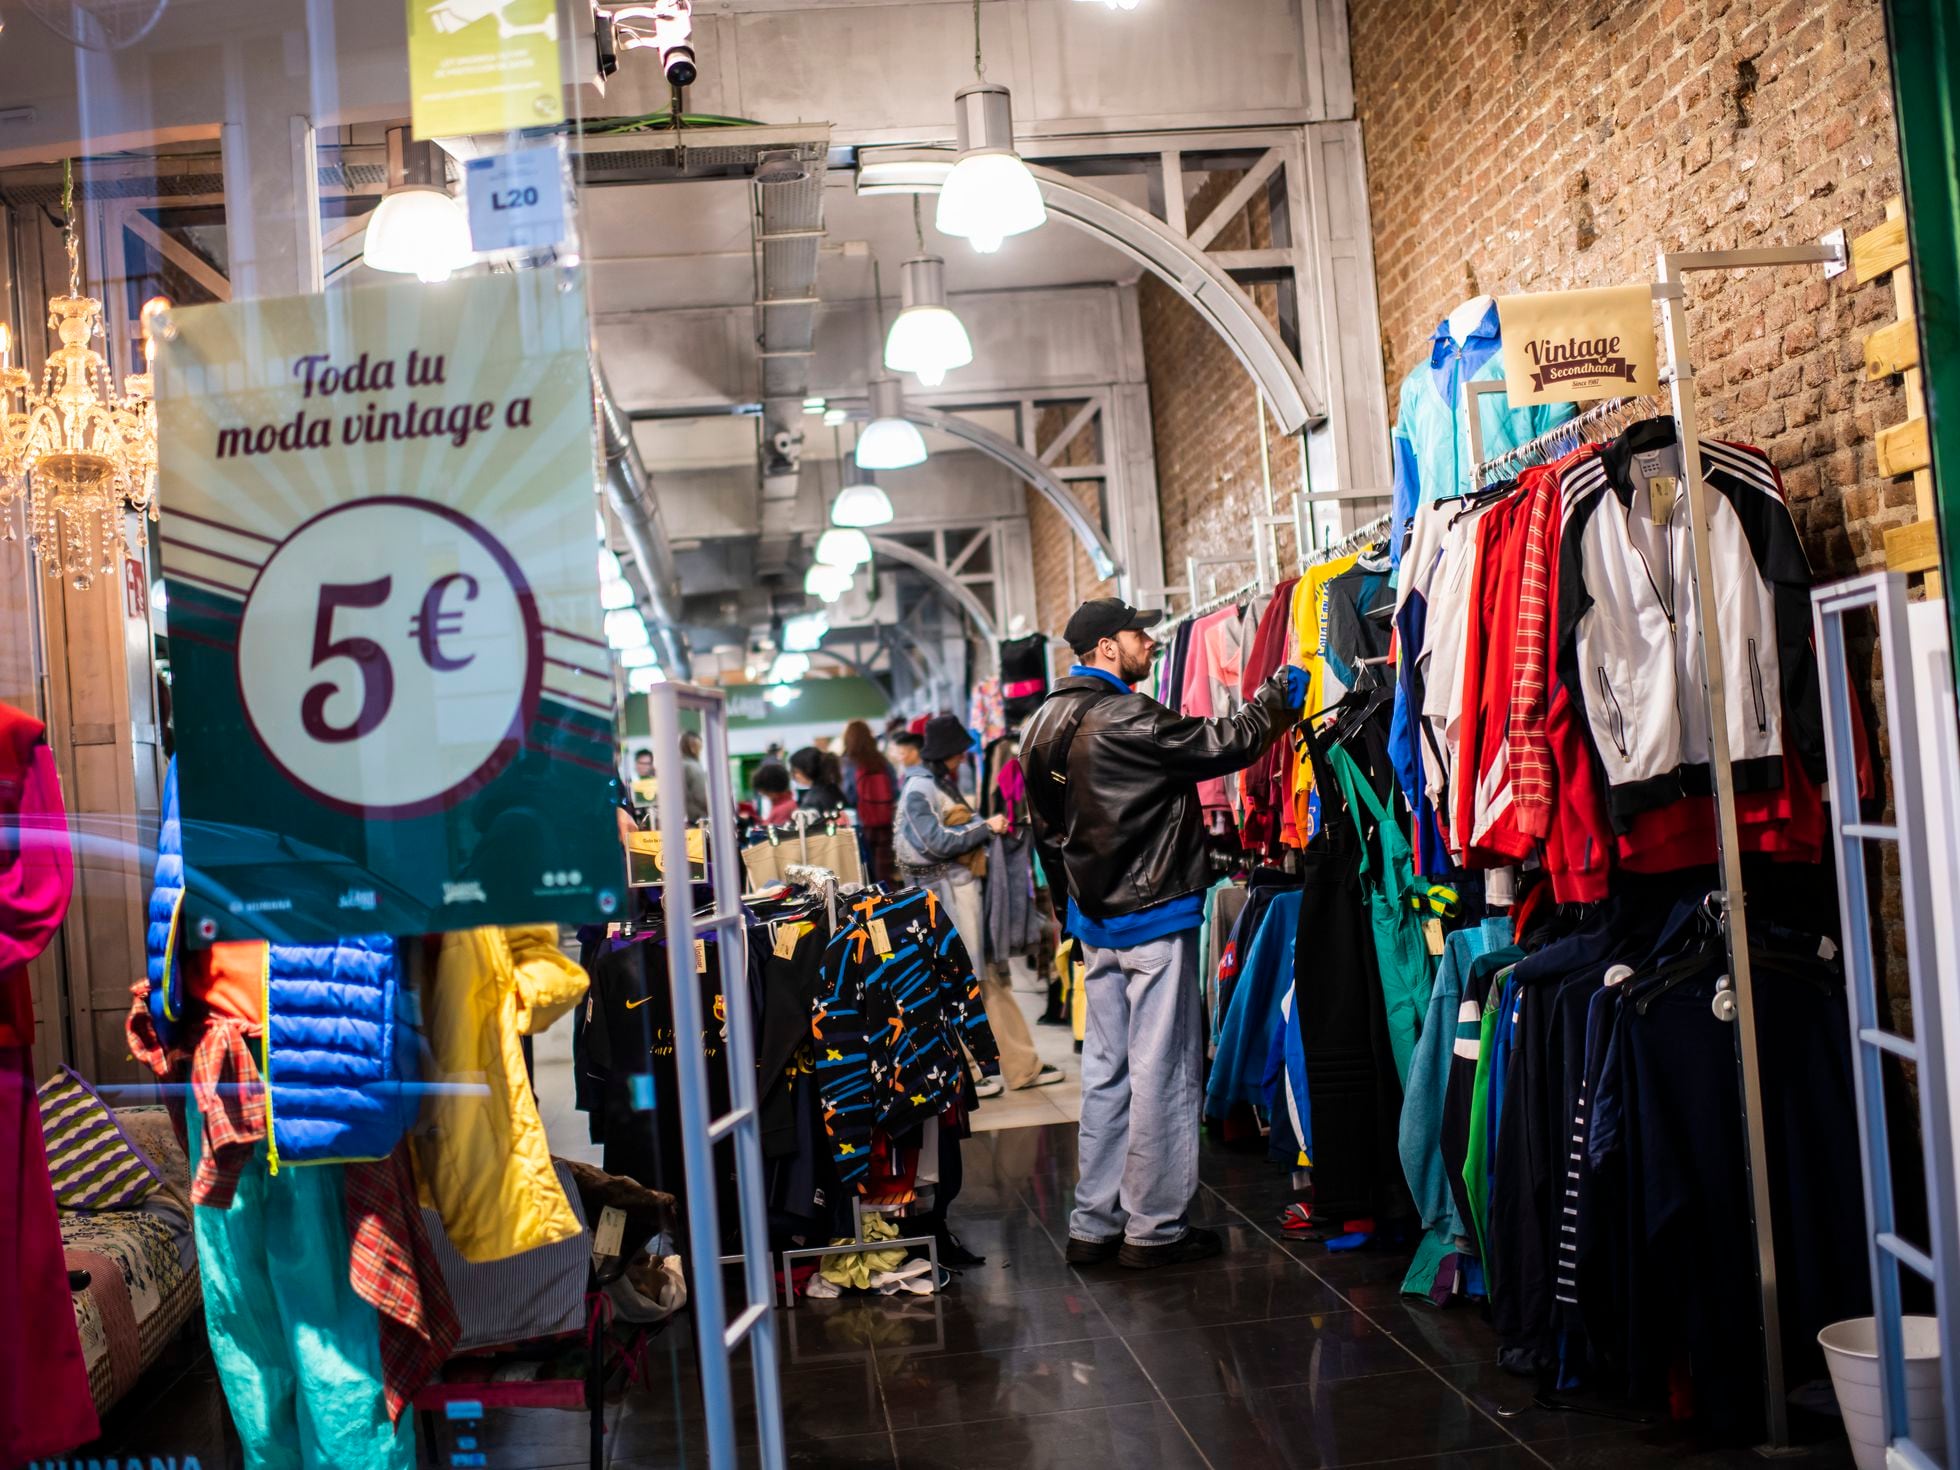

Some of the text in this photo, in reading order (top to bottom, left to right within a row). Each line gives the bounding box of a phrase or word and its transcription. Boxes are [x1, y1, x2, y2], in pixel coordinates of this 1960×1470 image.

[492, 186, 538, 211] L20
[1524, 336, 1620, 365] Vintage
[293, 349, 446, 398] Toda tu
[1550, 362, 1616, 380] Secondhand
[216, 397, 533, 458] moda vintage a
